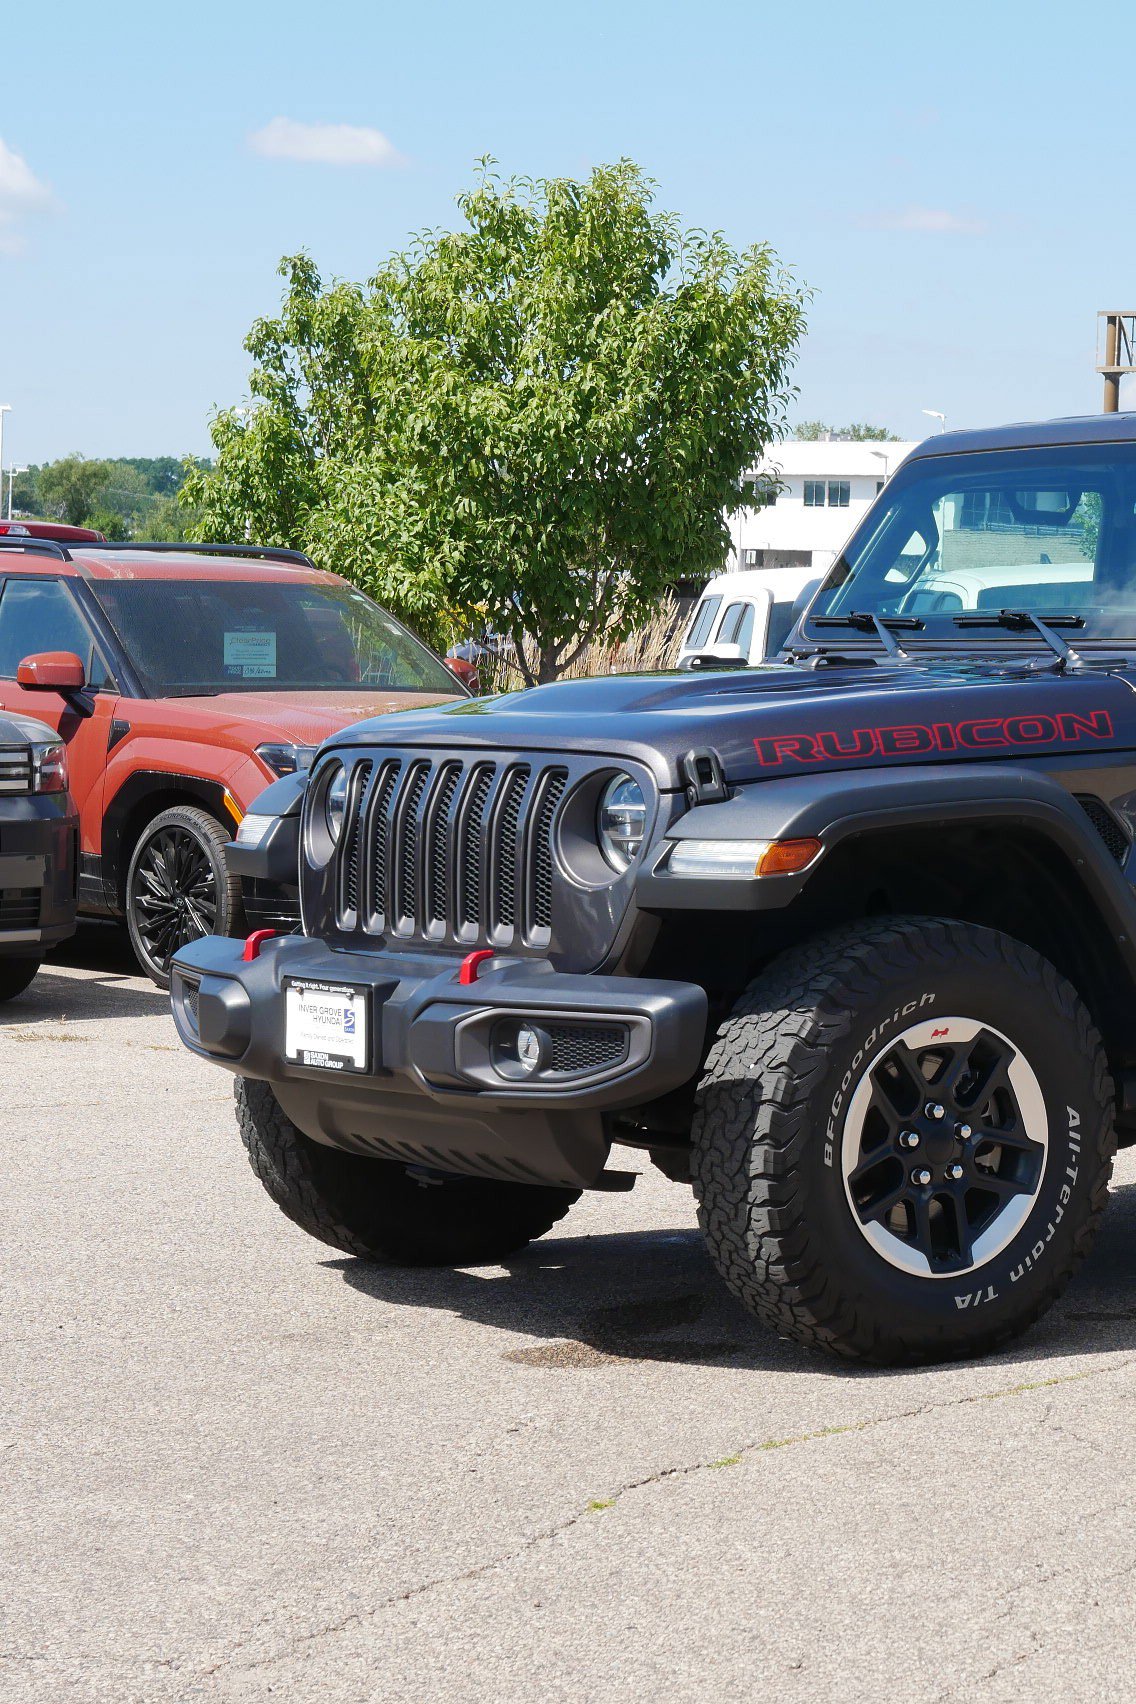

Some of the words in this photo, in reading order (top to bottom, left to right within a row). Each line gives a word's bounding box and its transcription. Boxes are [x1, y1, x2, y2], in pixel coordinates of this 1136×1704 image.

[753, 710, 1114, 766] RUBICON
[299, 1004, 318, 1014] INVER
[319, 1007, 342, 1017] GROVE
[312, 1015, 342, 1026] HYUNDAI
[310, 1052, 329, 1061] SAXON
[310, 1059, 324, 1067] AUTO
[324, 1060, 344, 1069] GROUP
[824, 992, 936, 1168] BFGoodrich
[1008, 1105, 1081, 1282] All-Terrain
[954, 1284, 999, 1310] T/A
